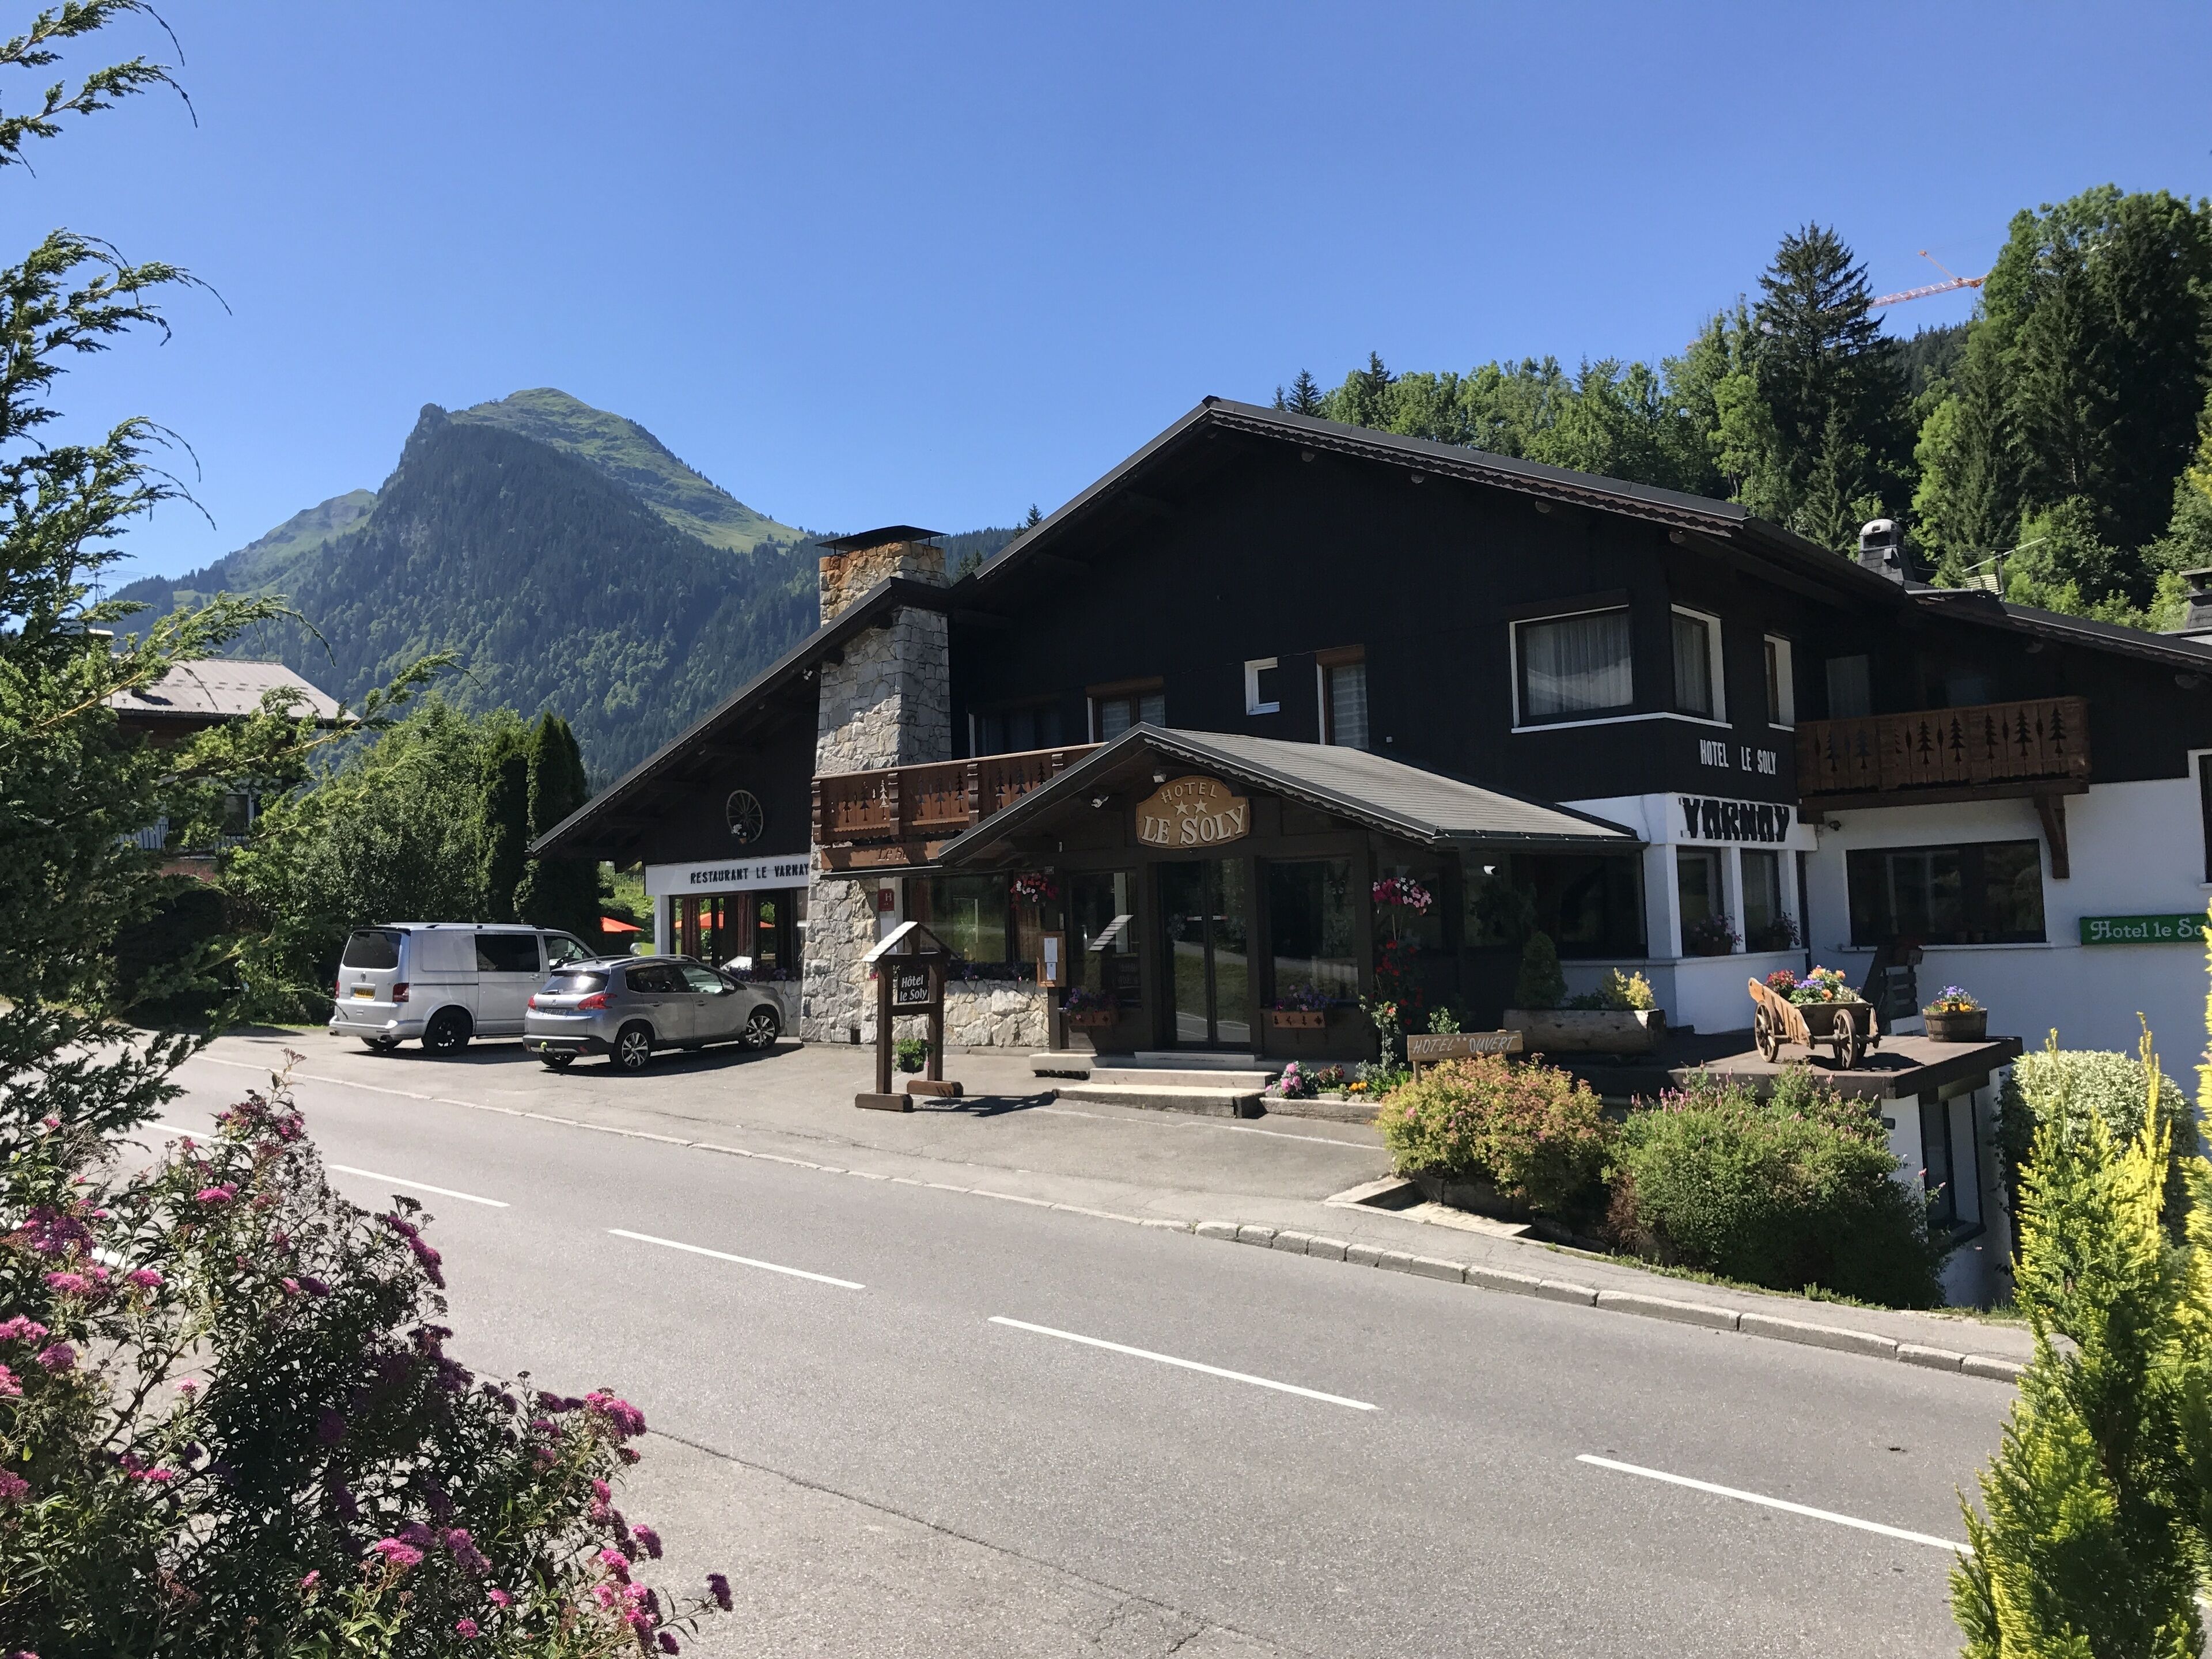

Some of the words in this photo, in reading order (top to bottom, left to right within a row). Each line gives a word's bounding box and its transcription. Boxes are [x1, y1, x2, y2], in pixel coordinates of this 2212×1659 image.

[1700, 739, 1729, 768] HOTEL
[1741, 746, 1752, 771] LE
[1758, 749, 1776, 775] SOLY
[1161, 782, 1217, 804] HOTEL
[1141, 816, 1171, 844] LE
[1180, 804, 1245, 844] SOLY
[690, 868, 749, 884] RESTAURANT
[756, 866, 767, 879] LE
[774, 863, 809, 877] VARNAY
[885, 893, 892, 902] H
[2090, 921, 2149, 940] Hotel
[2153, 922, 2172, 937] le
[901, 975, 923, 988] Hôtel
[900, 991, 907, 1001] le
[910, 988, 927, 1000] Soly
[1412, 1038, 1455, 1054] HOTEL
[1469, 1036, 1517, 1052] OUVERT
